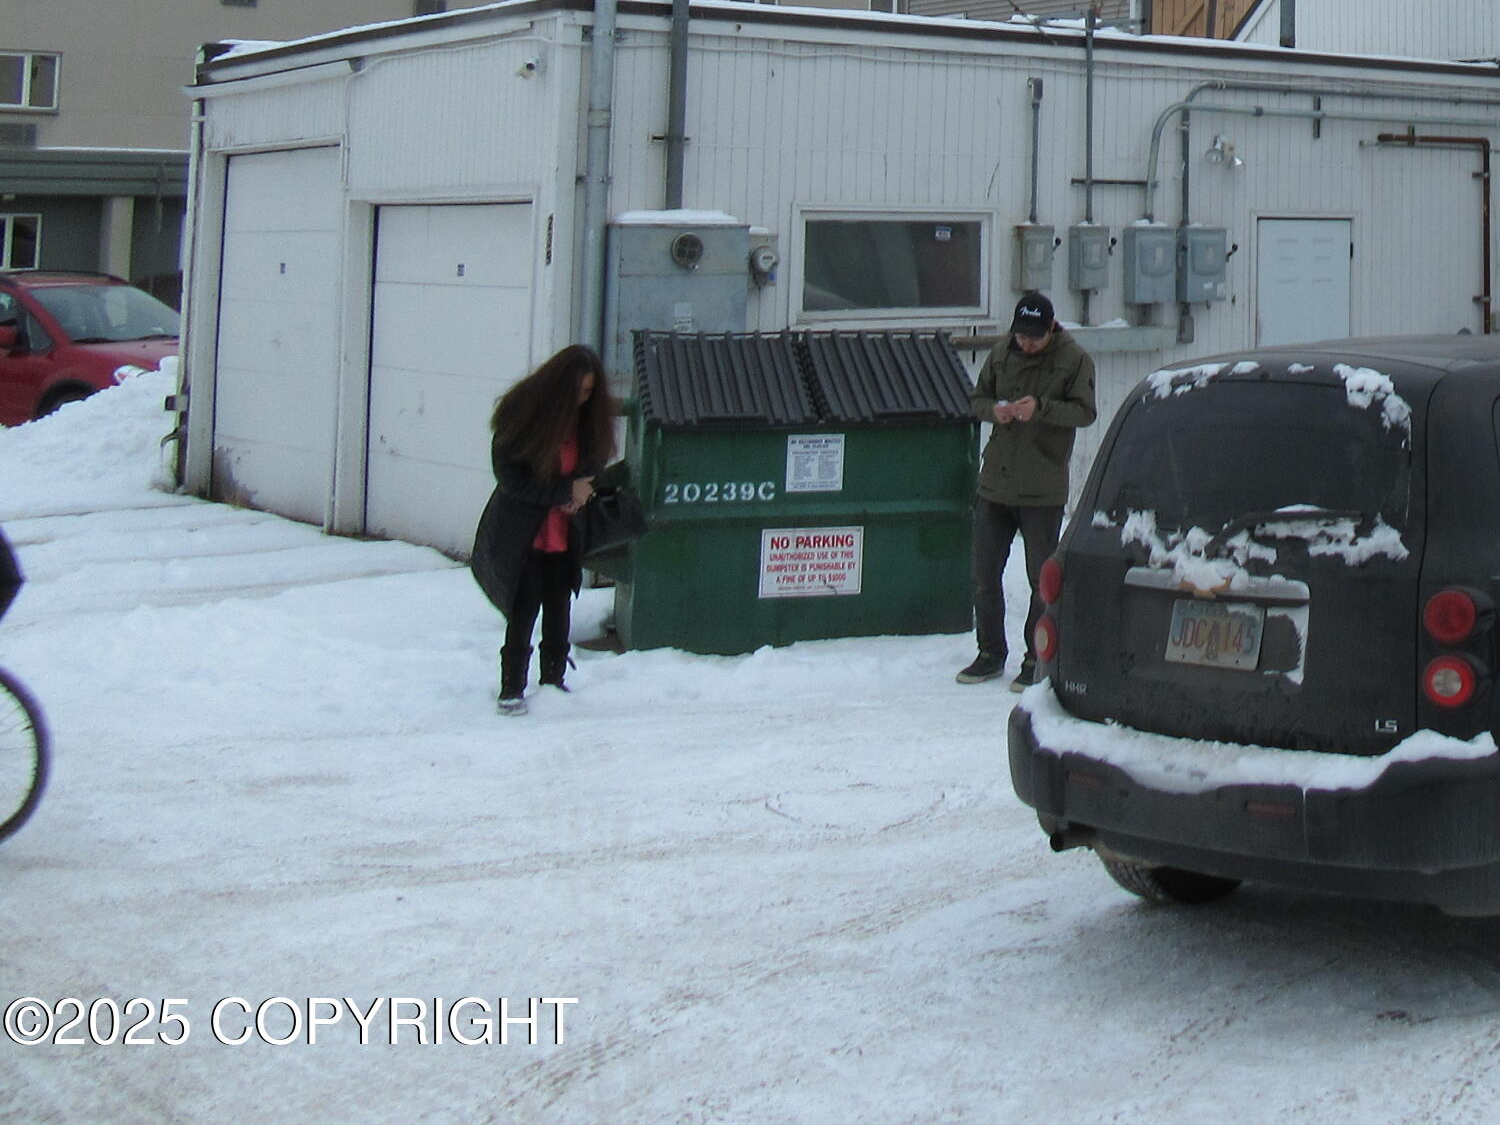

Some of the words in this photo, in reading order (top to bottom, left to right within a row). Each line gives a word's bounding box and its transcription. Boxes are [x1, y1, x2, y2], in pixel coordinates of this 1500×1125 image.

[664, 481, 776, 504] 20239C
[770, 536, 790, 550] NO
[796, 534, 854, 549] PARKING
[769, 552, 816, 562] UNAUTHORIZED
[817, 551, 828, 560] USE
[830, 551, 838, 559] OF
[841, 550, 854, 559] THIS
[767, 563, 799, 573] DUMPSTER
[801, 563, 807, 572] IS
[808, 562, 846, 572] PUNISHABLE
[847, 562, 856, 570] BY
[776, 575, 780, 584] A
[782, 575, 796, 584] FINE
[798, 575, 806, 583] OF
[807, 574, 816, 582] UP
[818, 574, 826, 582] TO
[1065, 679, 1087, 695] HHR
[1375, 719, 1398, 732] LS
